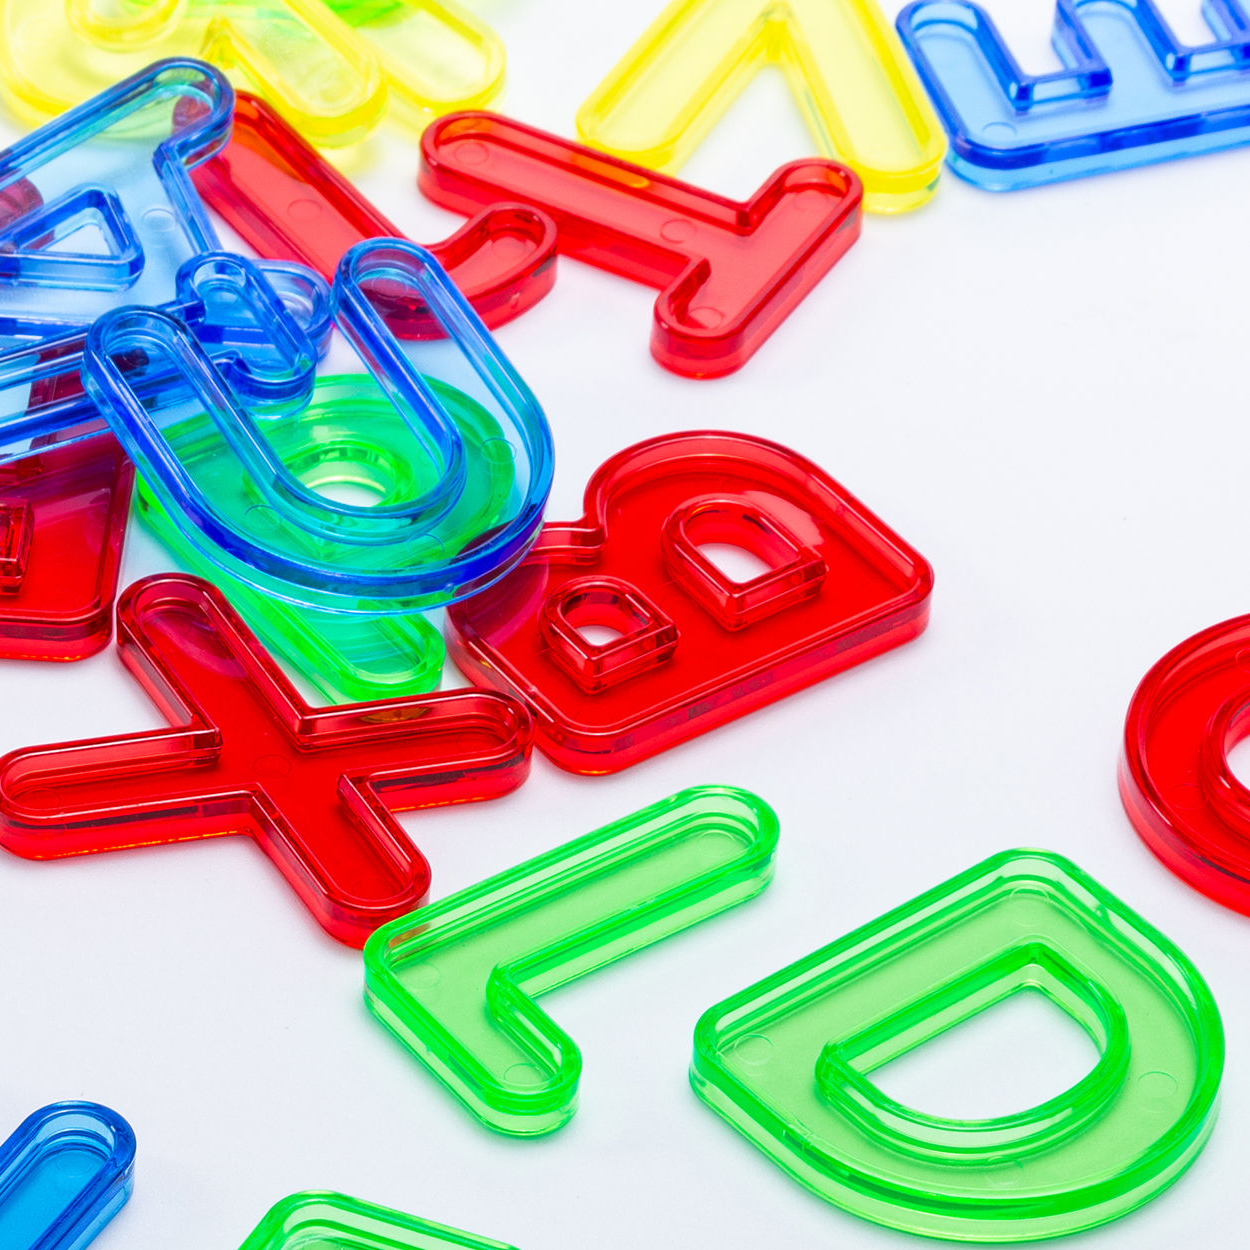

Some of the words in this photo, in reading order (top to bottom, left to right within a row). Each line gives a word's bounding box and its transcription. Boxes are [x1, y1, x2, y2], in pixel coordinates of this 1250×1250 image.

[418, 110, 863, 380] T
[82, 236, 555, 614] U
[445, 429, 935, 777] B
[364, 784, 781, 1137] L
[688, 847, 1227, 1244] D
